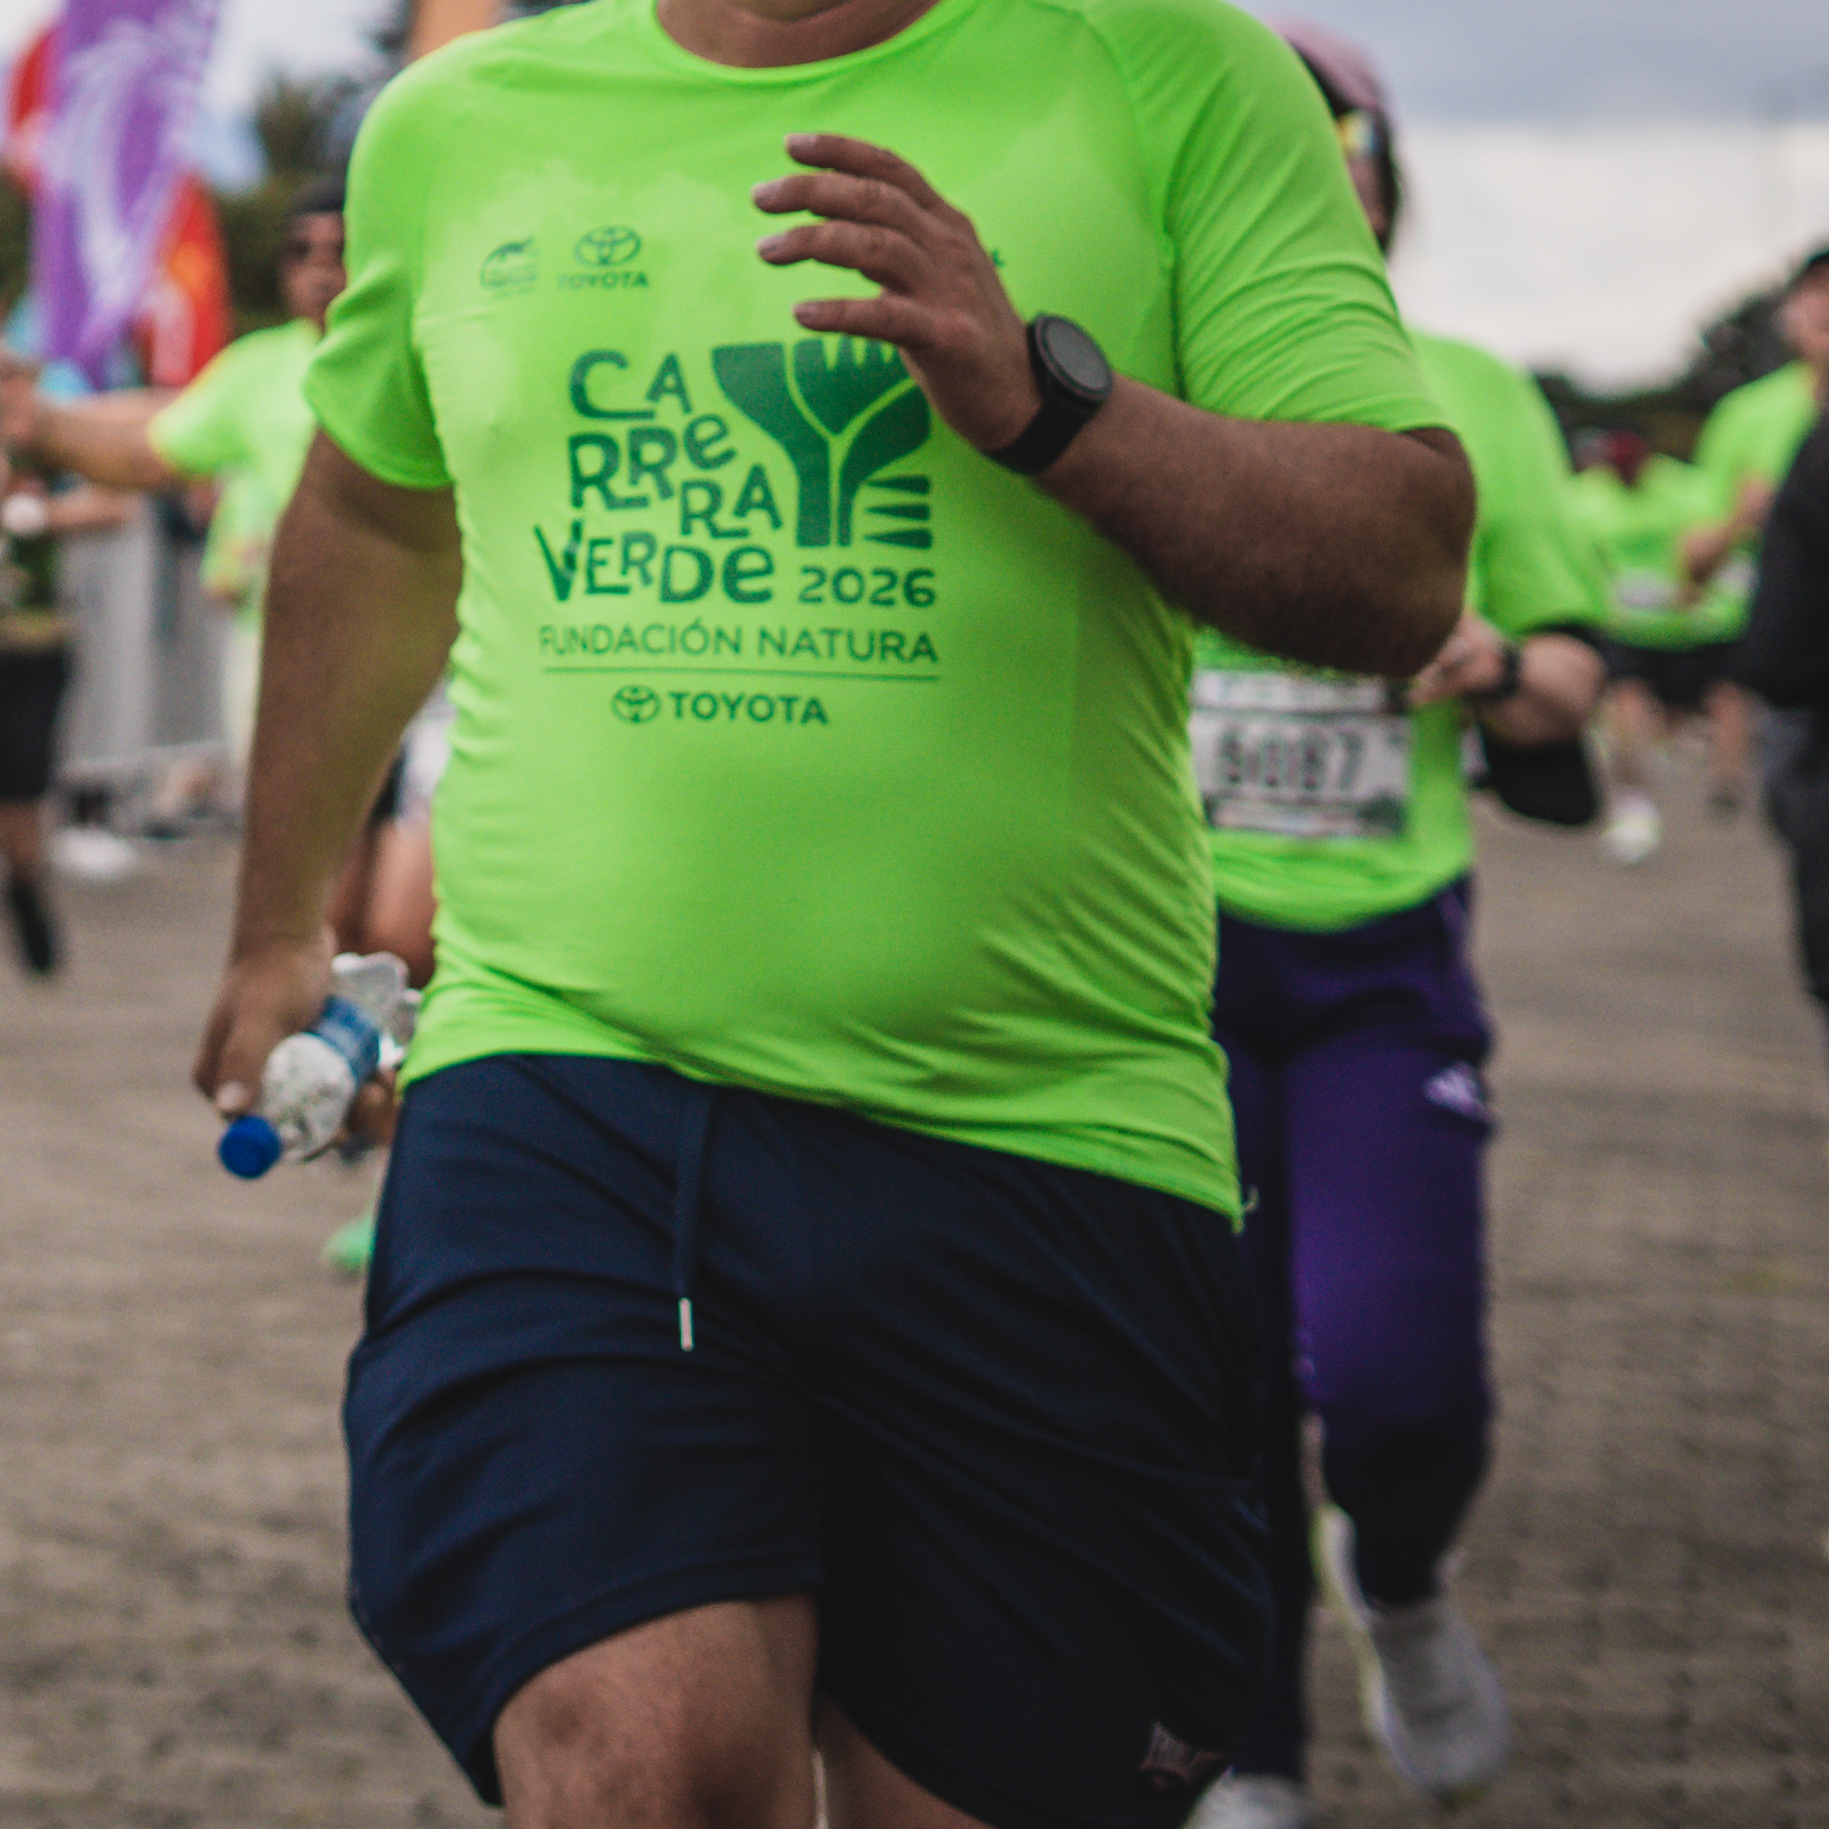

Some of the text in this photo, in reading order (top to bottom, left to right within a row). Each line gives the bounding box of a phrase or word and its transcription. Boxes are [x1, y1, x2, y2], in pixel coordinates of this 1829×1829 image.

[558, 271, 649, 289] TOYOTA
[798, 567, 936, 607] 2026
[540, 617, 940, 664] FUNDACIÓN NATURA
[668, 691, 830, 725] TOYOTA
